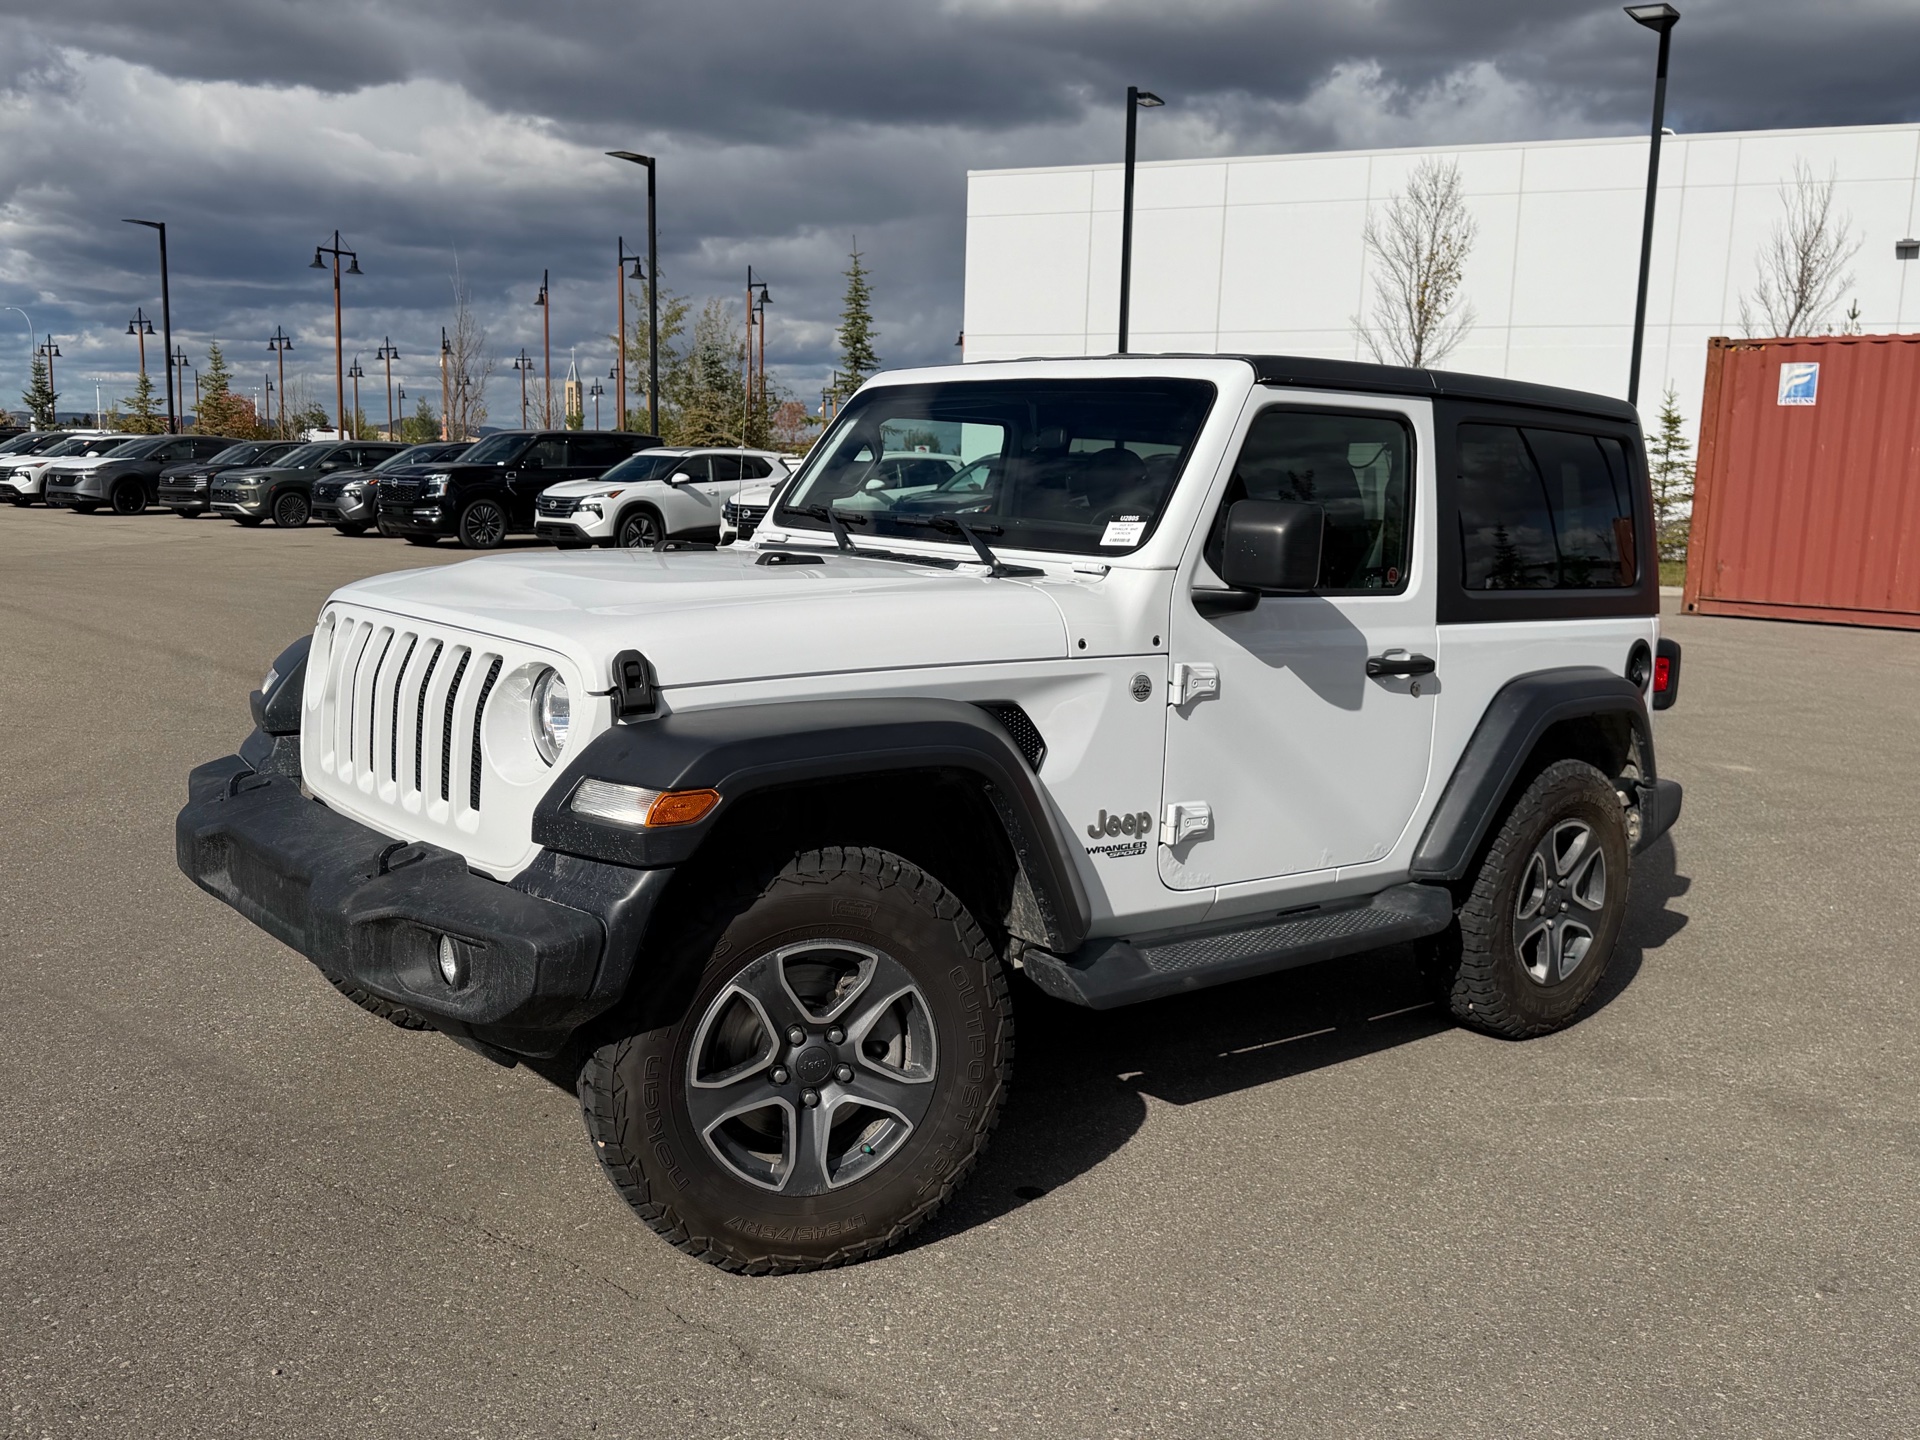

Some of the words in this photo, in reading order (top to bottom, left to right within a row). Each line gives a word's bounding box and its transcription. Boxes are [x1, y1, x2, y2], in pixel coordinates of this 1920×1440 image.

[1087, 809, 1153, 840] Jeep
[1085, 841, 1148, 855] WRANGLER
[1109, 849, 1145, 858] SPORT
[949, 965, 988, 1131] OUTPOST
